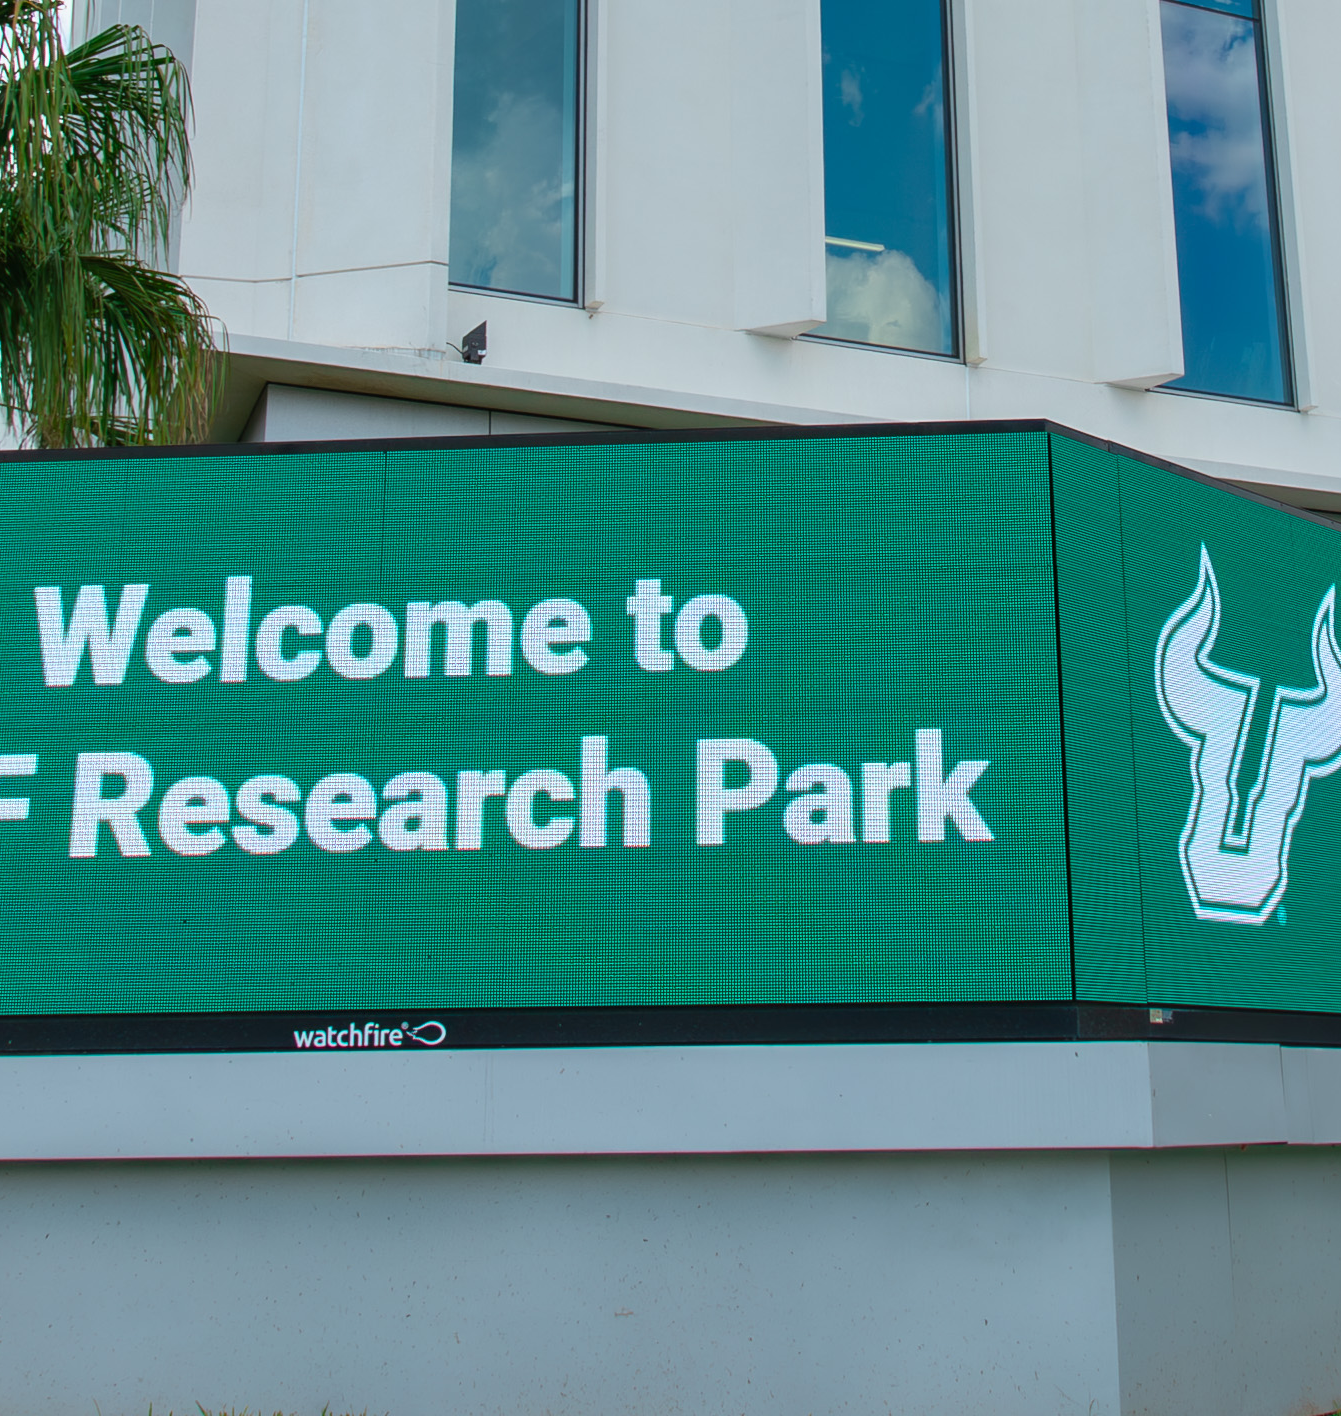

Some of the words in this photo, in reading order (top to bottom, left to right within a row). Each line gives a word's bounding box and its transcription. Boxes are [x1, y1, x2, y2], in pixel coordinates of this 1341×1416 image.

[34, 575, 592, 687] Welcome
[626, 578, 749, 673] to
[69, 735, 652, 859] Research
[695, 728, 995, 845] Park
[293, 1021, 404, 1049] watchfire
